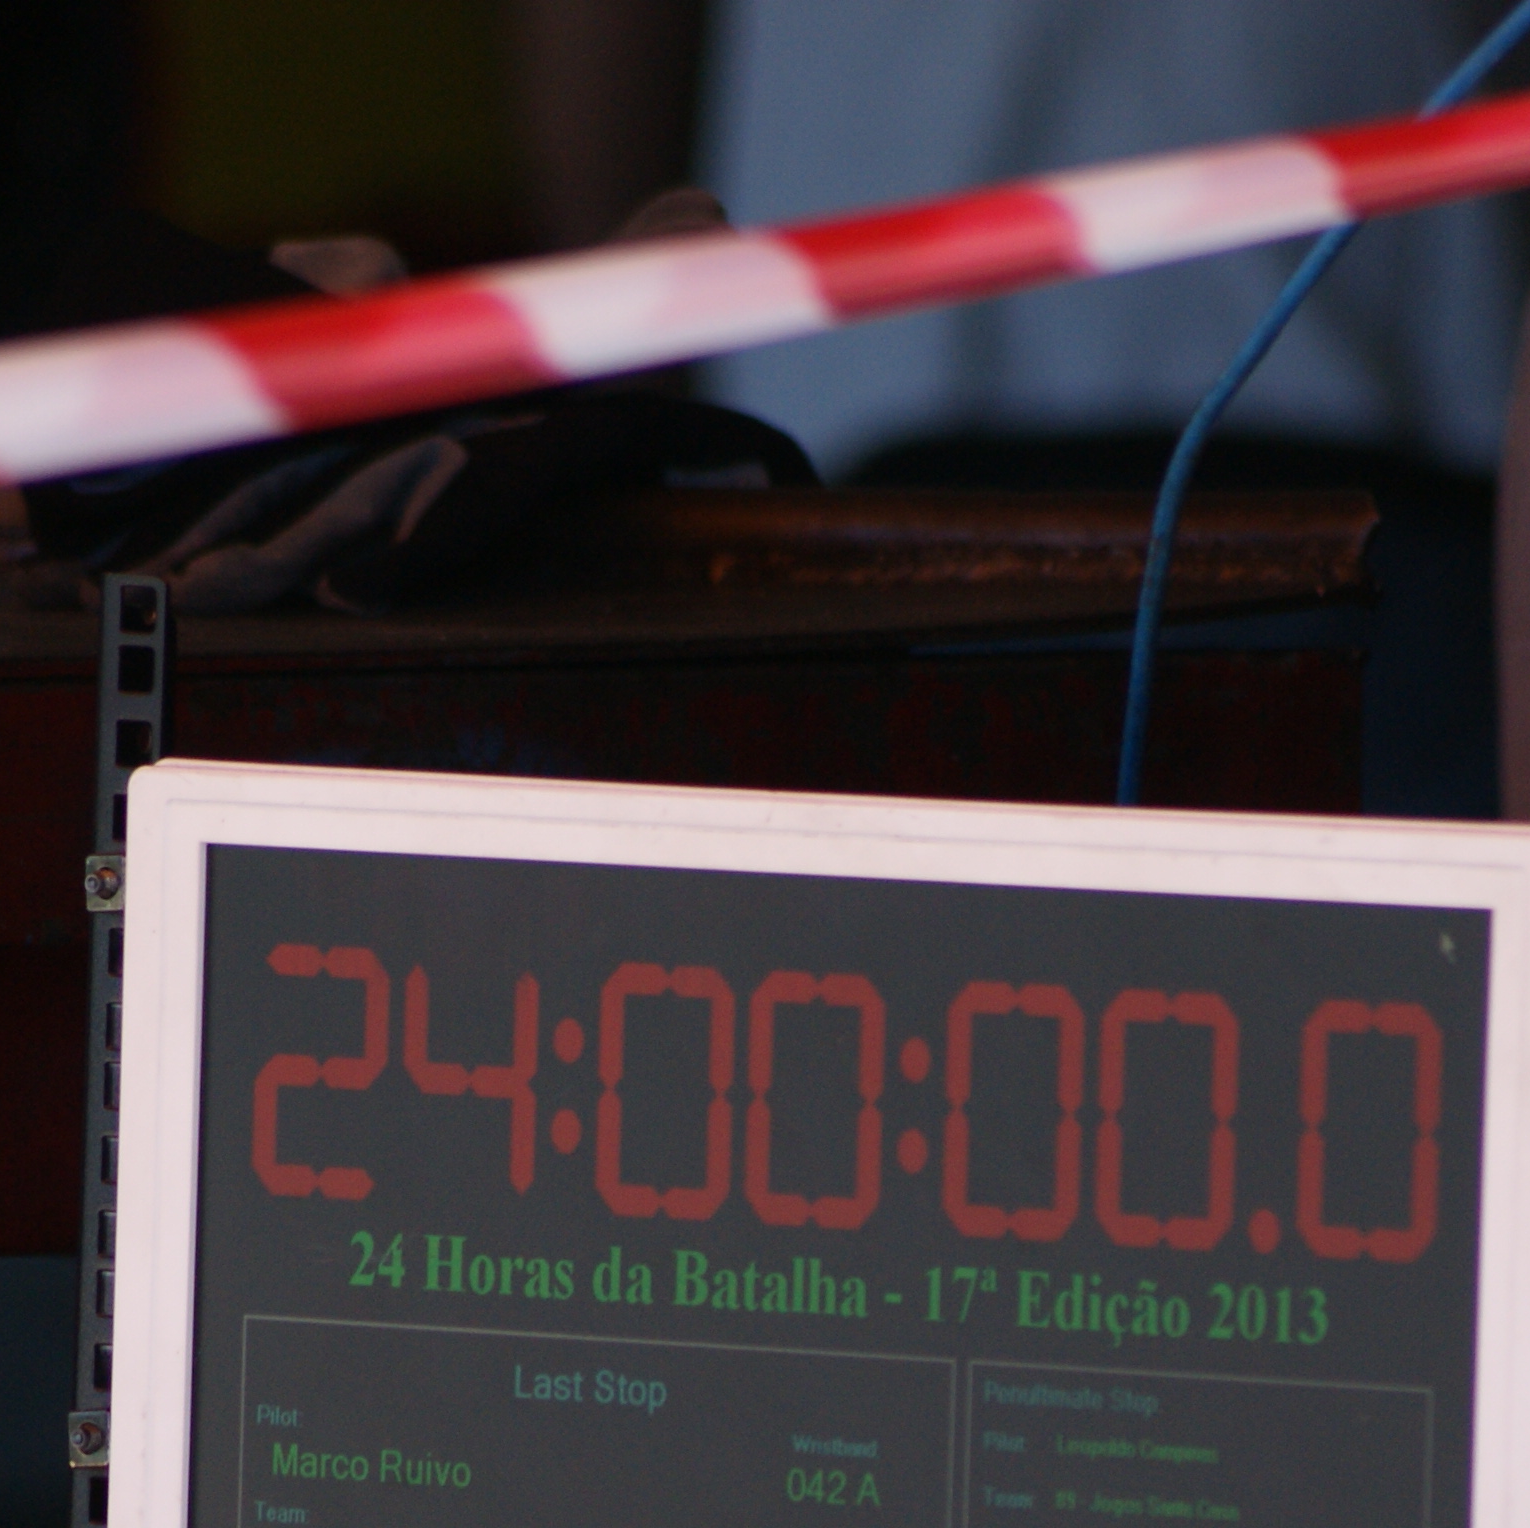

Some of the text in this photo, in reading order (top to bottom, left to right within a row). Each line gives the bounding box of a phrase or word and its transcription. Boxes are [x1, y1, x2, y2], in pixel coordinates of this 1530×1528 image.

[252, 943, 1442, 1267] 24:00:00.0
[349, 1230, 404, 1287] 24
[425, 1235, 574, 1299] Horas
[592, 1246, 652, 1304] da
[674, 1250, 866, 1317] Batalha
[927, 1266, 996, 1321] 17ª
[1018, 1270, 1189, 1345] Edição
[1208, 1282, 1328, 1344] 2013
[513, 1365, 668, 1413] Last Stop
[272, 1443, 471, 1488] Marco Ruivo
[786, 1467, 880, 1505] 042 A
